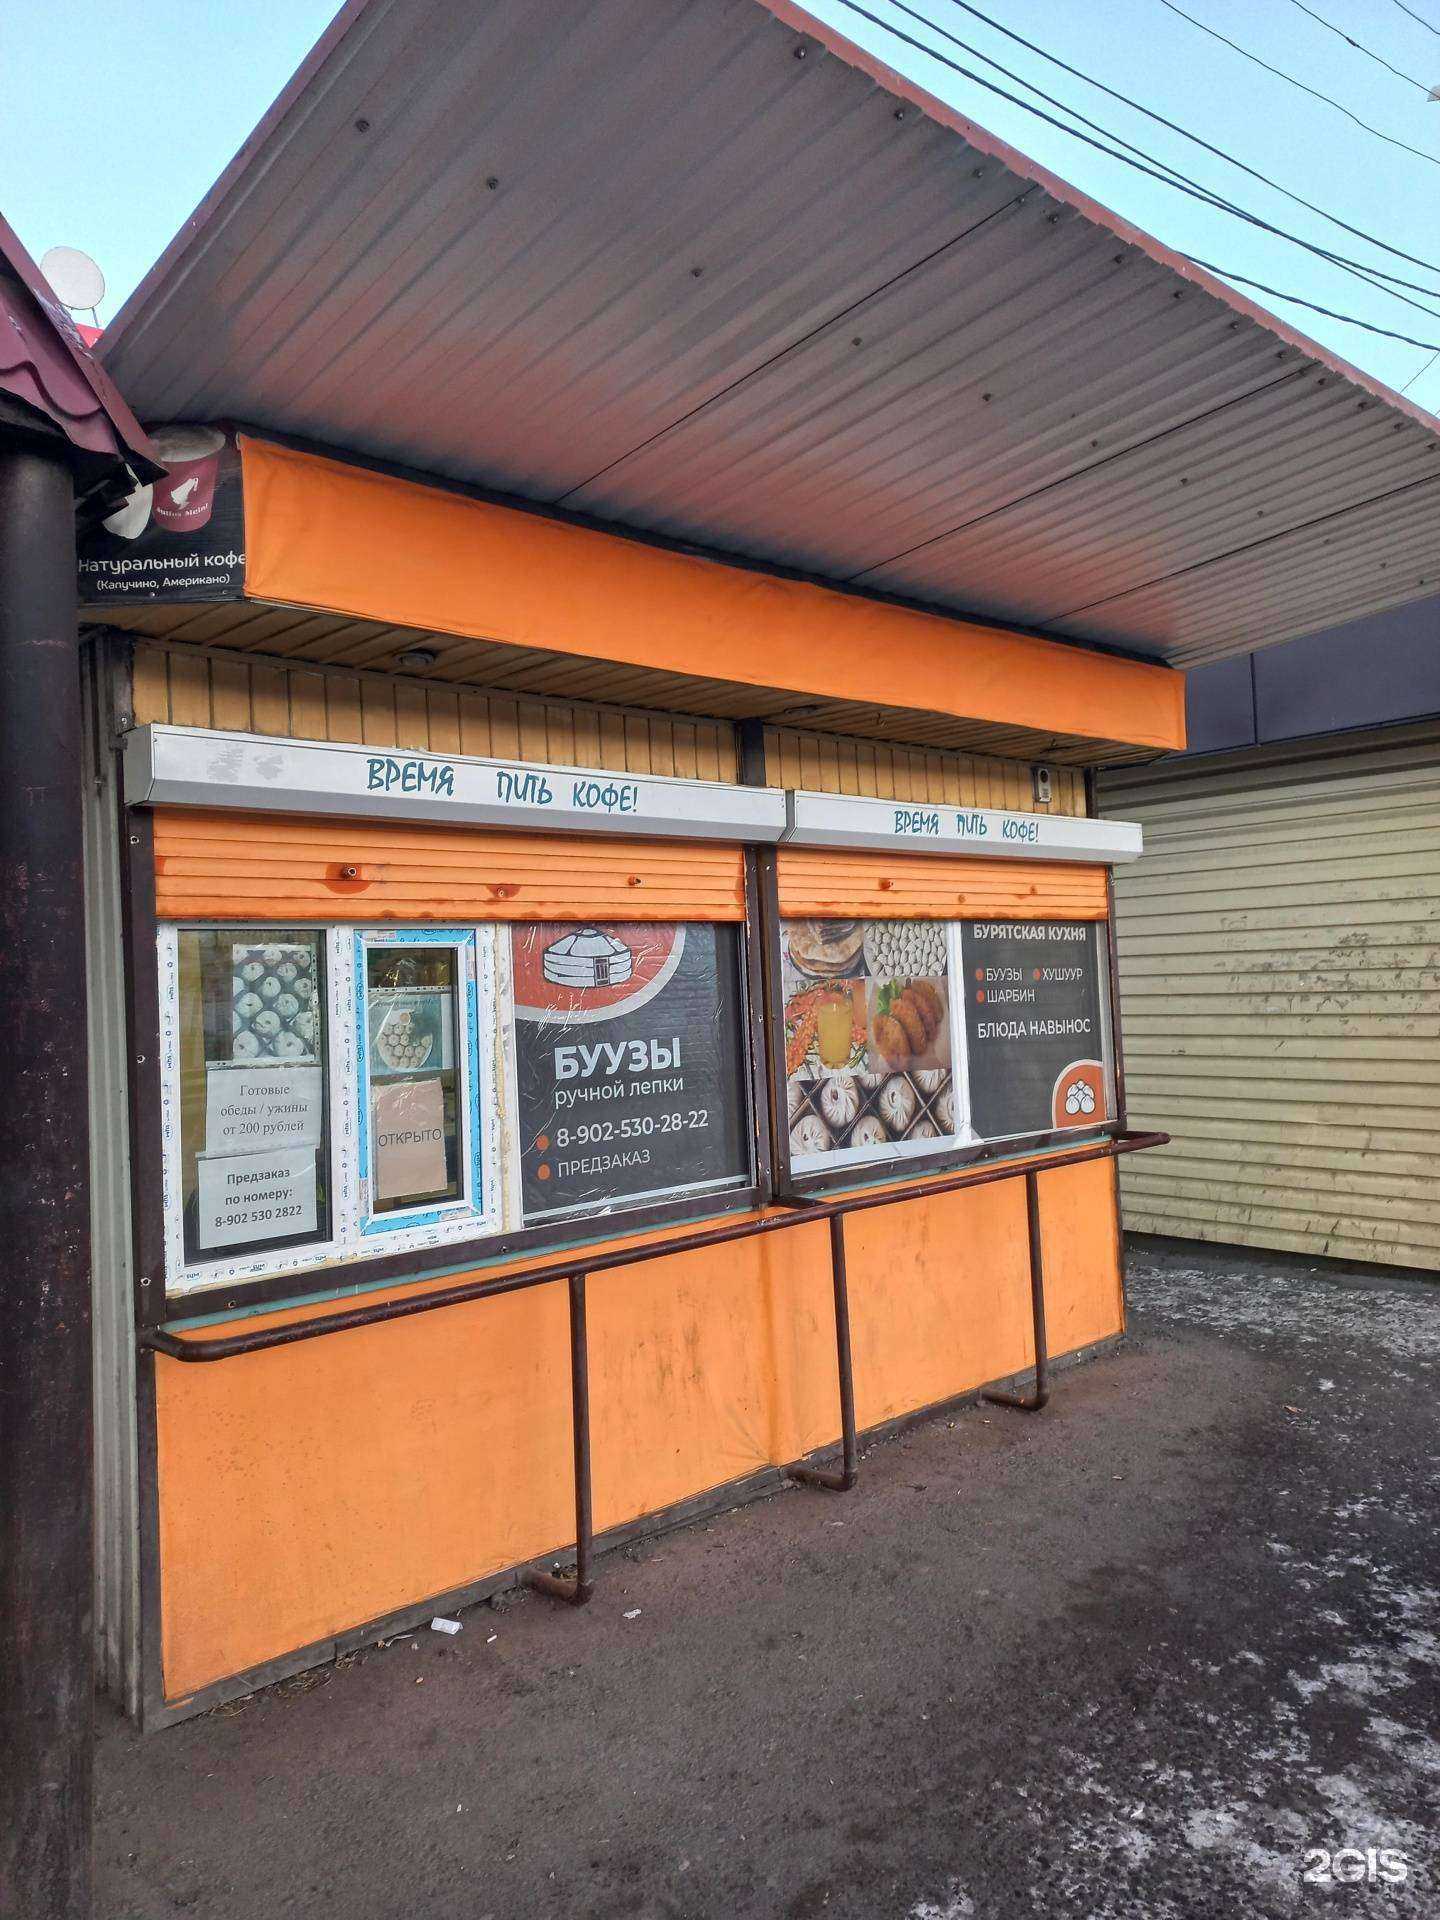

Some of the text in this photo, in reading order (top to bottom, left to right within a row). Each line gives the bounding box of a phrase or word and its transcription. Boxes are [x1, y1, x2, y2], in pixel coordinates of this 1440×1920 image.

[78, 550, 247, 575] Натуральный кофе
[96, 573, 231, 591] (Капучино, Американо)
[367, 758, 638, 813] ВРЕМЯ ПИТЬ КОФЕ!
[894, 810, 1039, 843] ВРЕМЯ ПИТЬ КОФЕ!
[973, 924, 1087, 942] БУРЯТСКАЯ КУХНЯ
[986, 967, 1084, 982] БУУЗЫ ХУШУУР
[987, 989, 1036, 1004] ШАРБИН
[978, 1018, 1091, 1039] БЛЮДА НАВЫНОС
[554, 1037, 682, 1080] БУУЗЫ
[239, 1084, 291, 1097] Готовые
[554, 1077, 684, 1109] ручной лепки
[220, 1103, 257, 1117] обеды
[267, 1102, 308, 1116] ужины
[222, 1120, 305, 1137] от 200 рублей
[378, 1128, 443, 1147] ОТКРЫТО
[555, 1109, 710, 1148] 8-902-530-28-22
[557, 1149, 651, 1178] ПРЕДЗАКАЗ
[227, 1168, 290, 1186] Предзаказ
[225, 1188, 294, 1206] по номеру:
[214, 1205, 303, 1228] 8-902 530 2822
